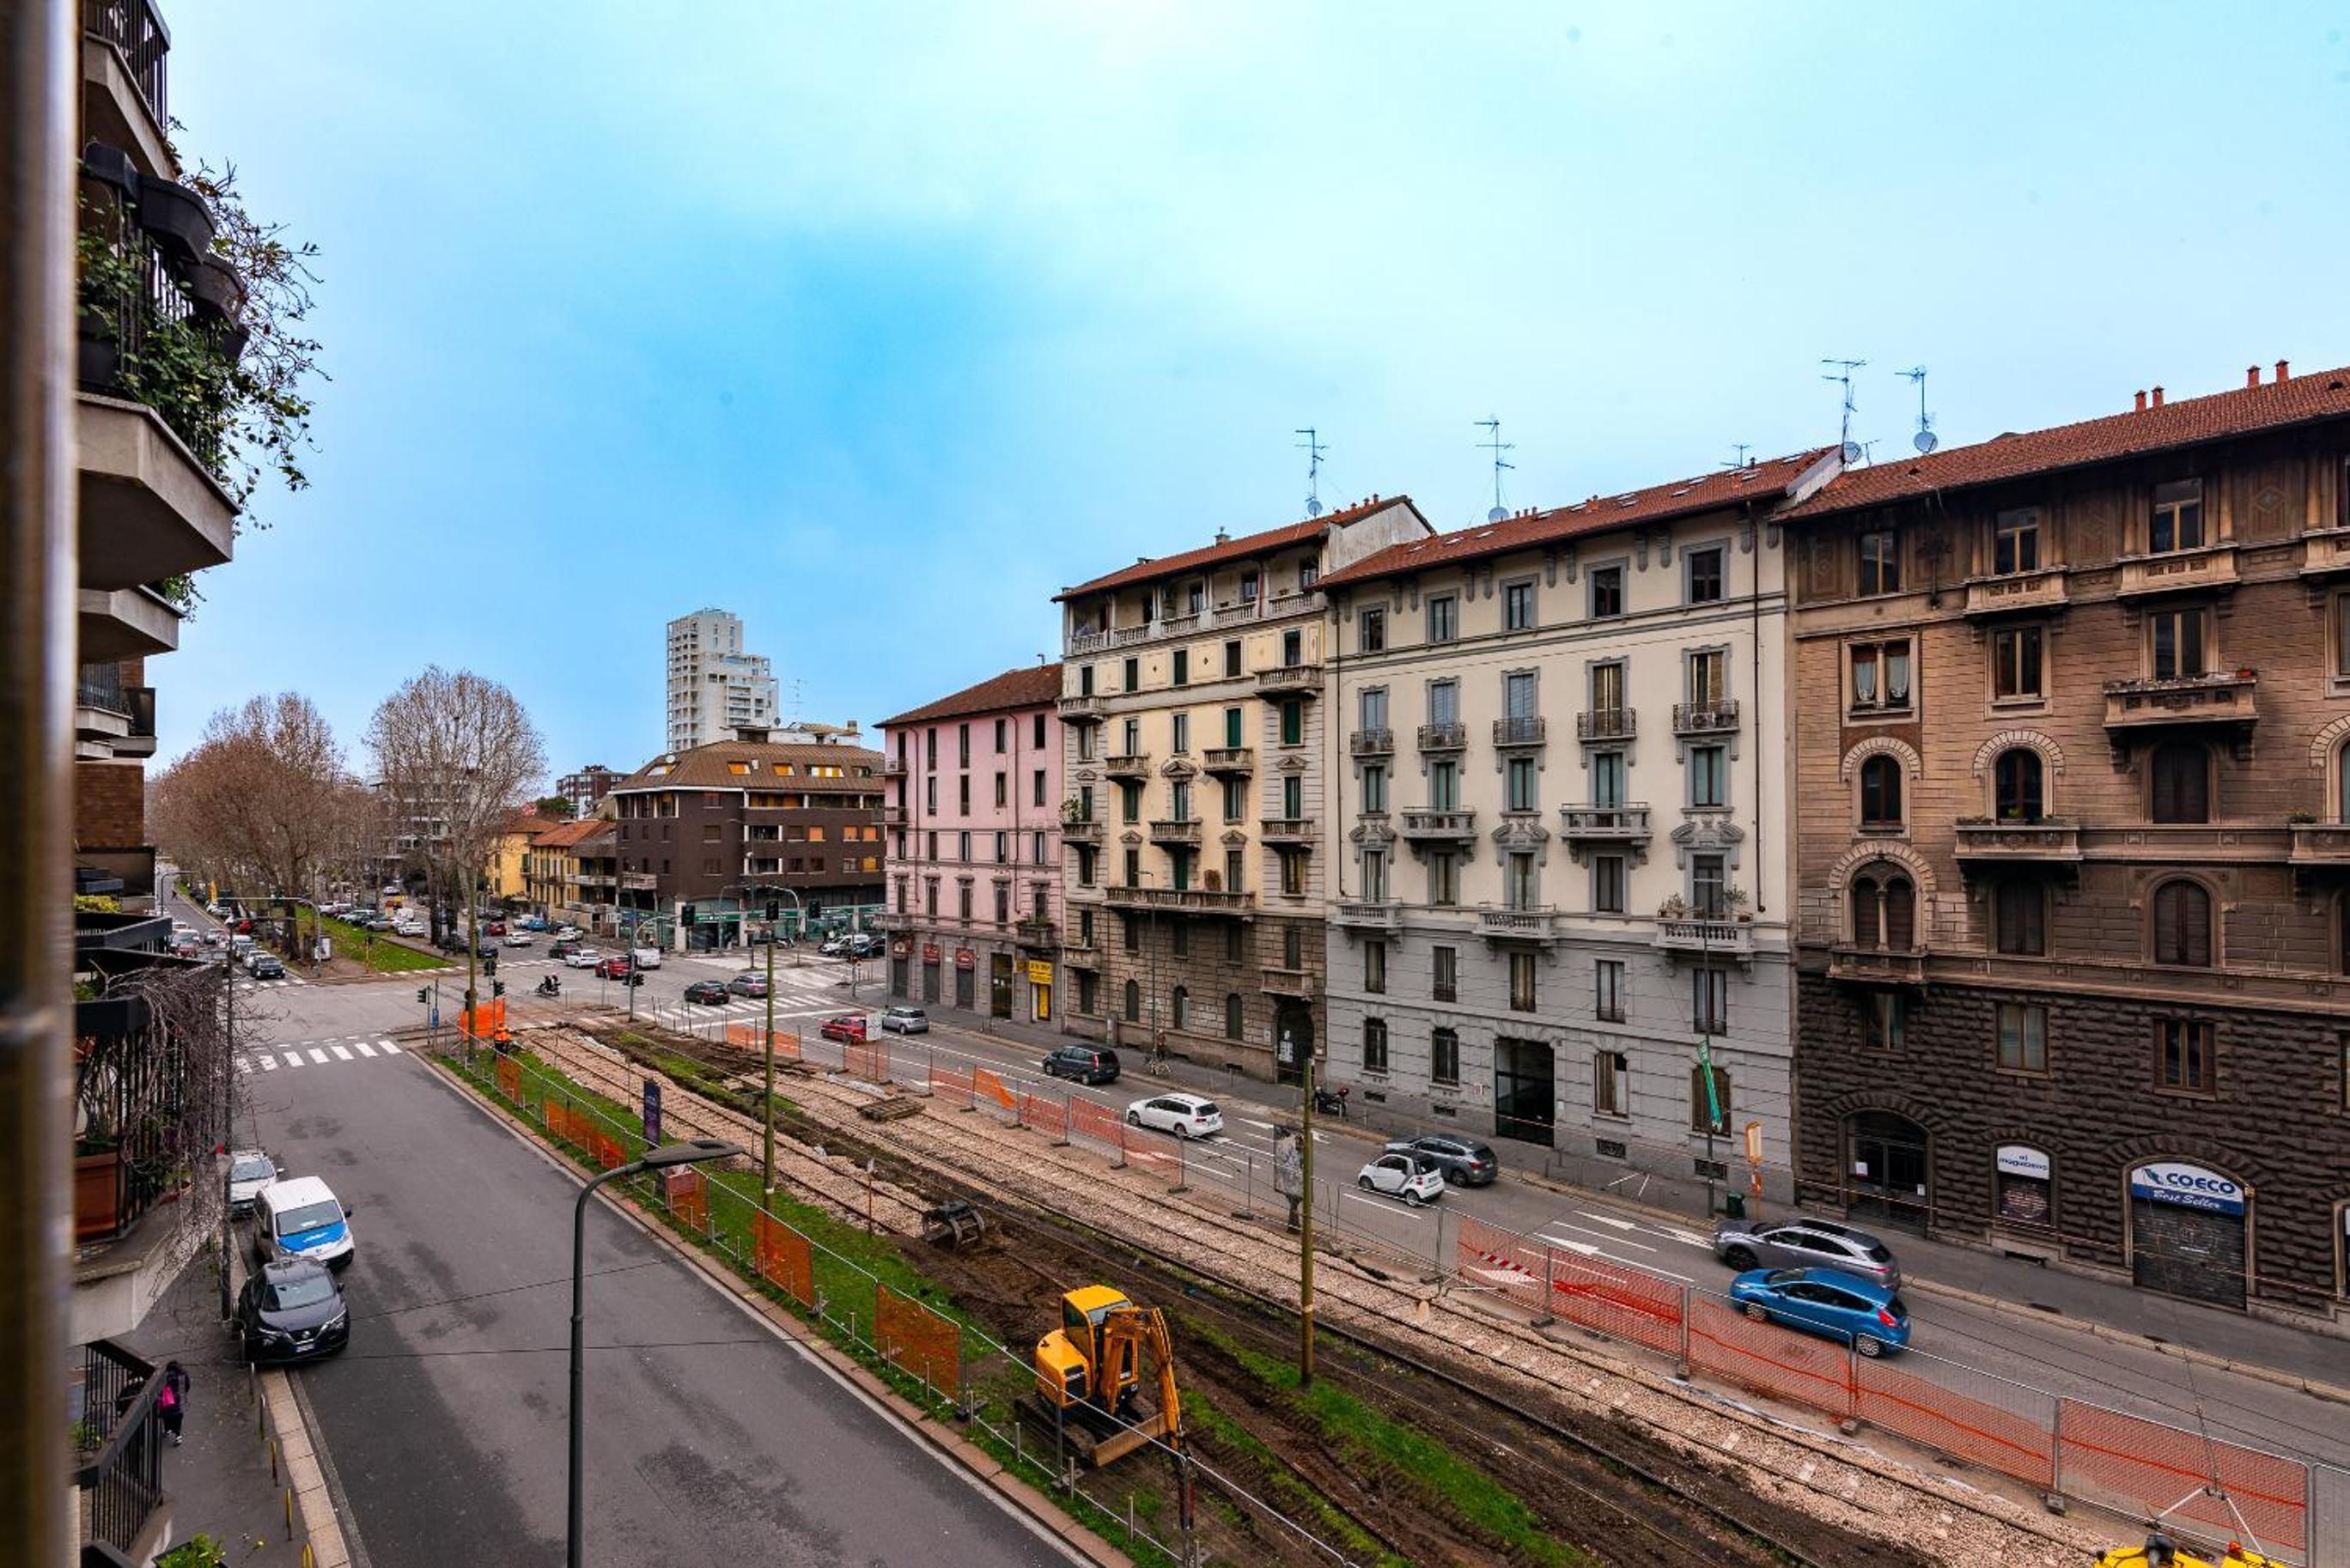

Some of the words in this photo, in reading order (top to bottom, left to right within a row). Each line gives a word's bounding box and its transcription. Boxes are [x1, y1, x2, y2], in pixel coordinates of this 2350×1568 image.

[2166, 1173, 2236, 1194] COECO
[2153, 1189, 2180, 1202] Best
[2183, 1194, 2220, 1209] Seller
